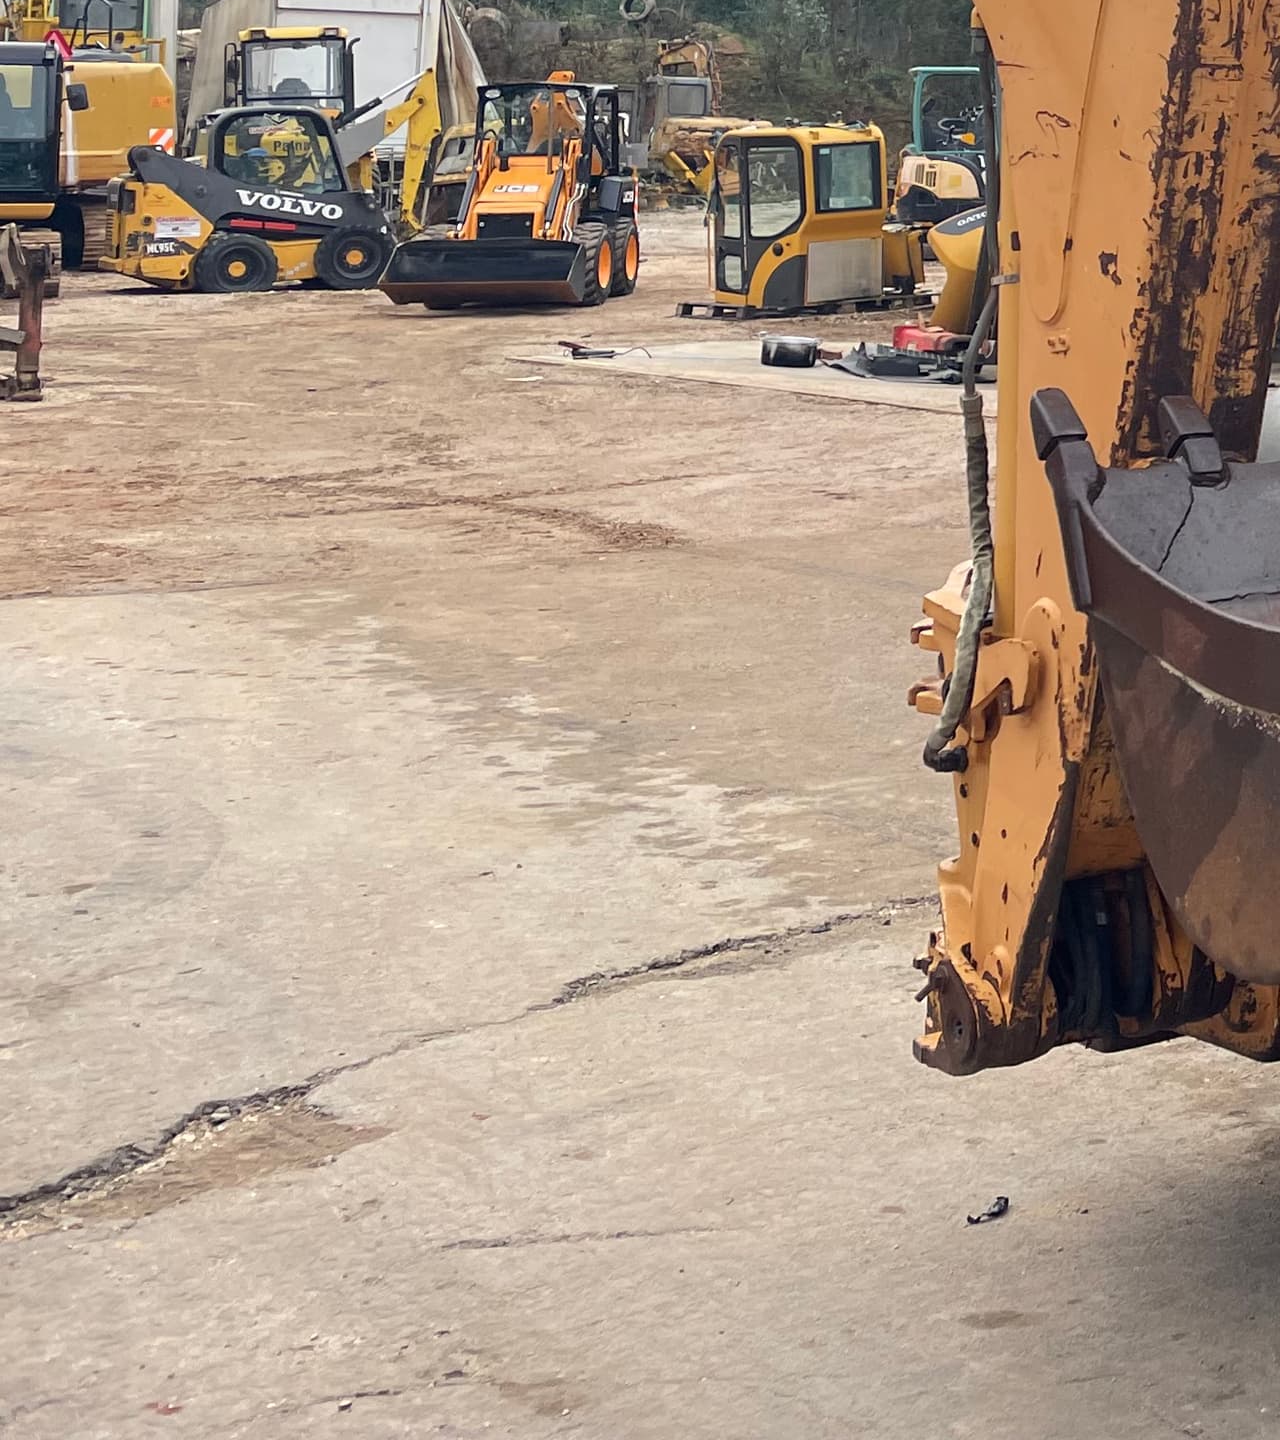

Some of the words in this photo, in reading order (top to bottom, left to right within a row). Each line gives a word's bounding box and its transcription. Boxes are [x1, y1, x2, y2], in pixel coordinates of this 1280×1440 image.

[493, 184, 540, 193] JCB
[235, 189, 343, 220] VOLVO
[956, 211, 988, 226] OLVO
